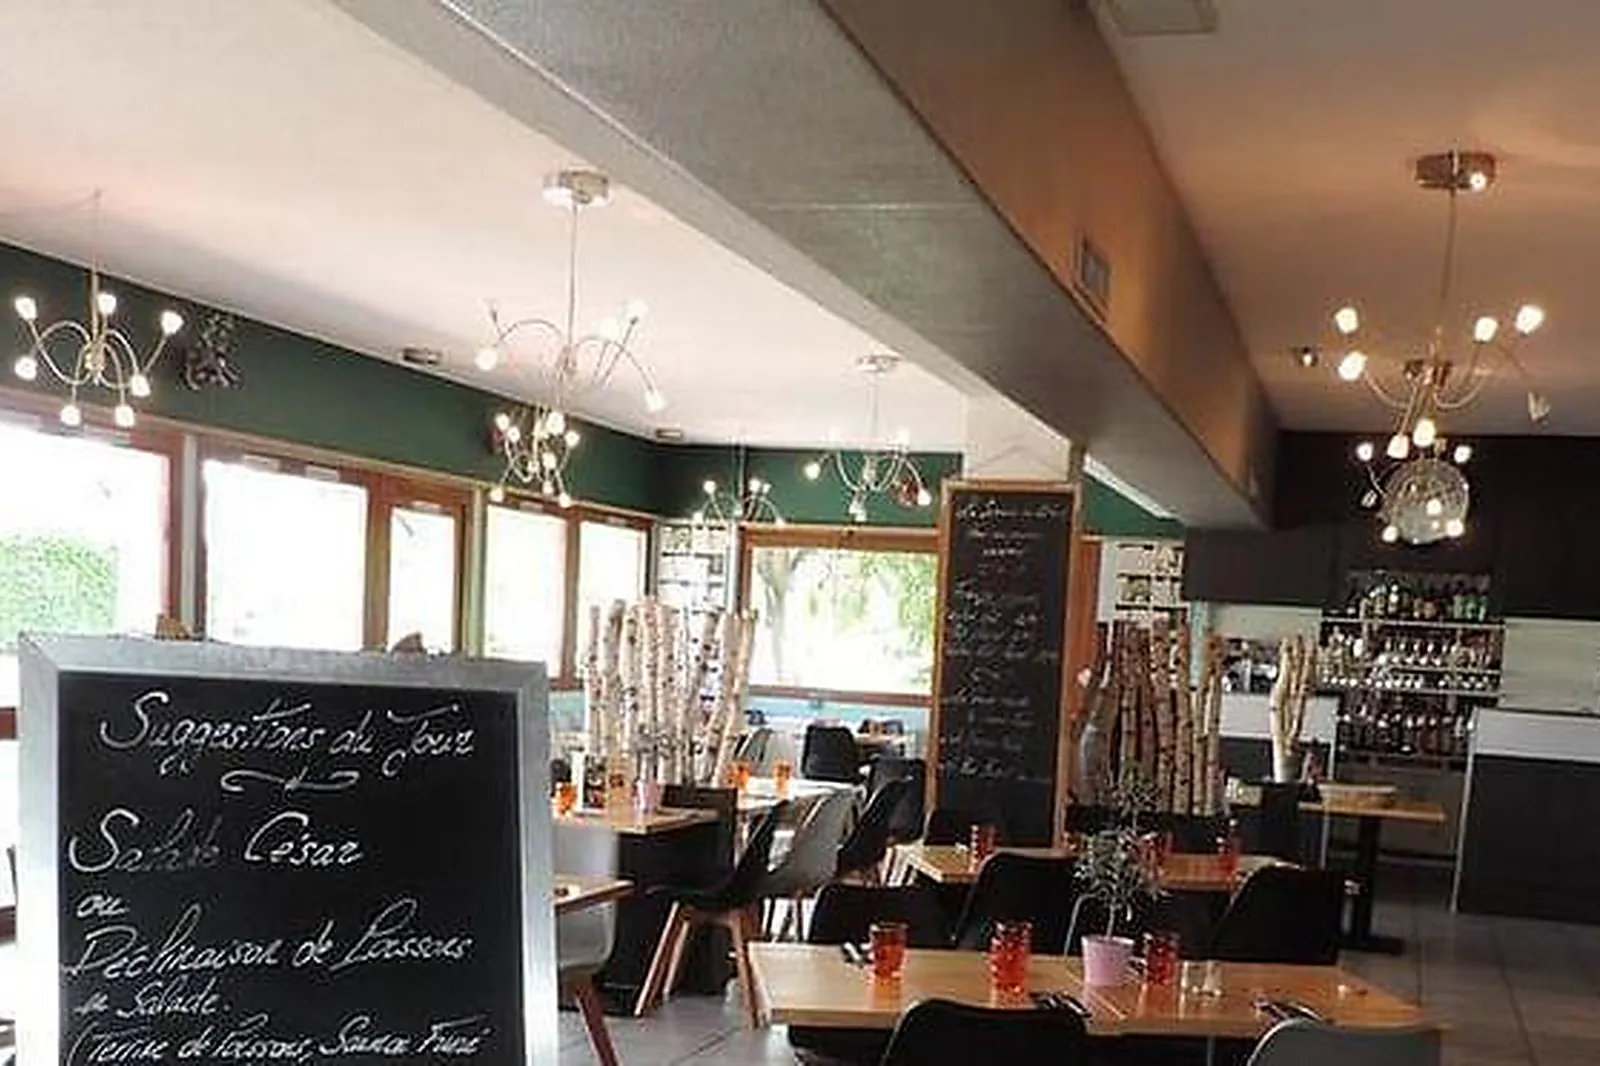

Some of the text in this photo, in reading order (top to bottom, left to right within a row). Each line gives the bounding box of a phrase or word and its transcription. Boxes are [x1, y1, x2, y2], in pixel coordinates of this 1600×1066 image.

[100, 691, 326, 775] Suggestions
[329, 710, 375, 754] du
[244, 811, 364, 862] César
[76, 895, 128, 917] ou
[292, 919, 334, 967] de
